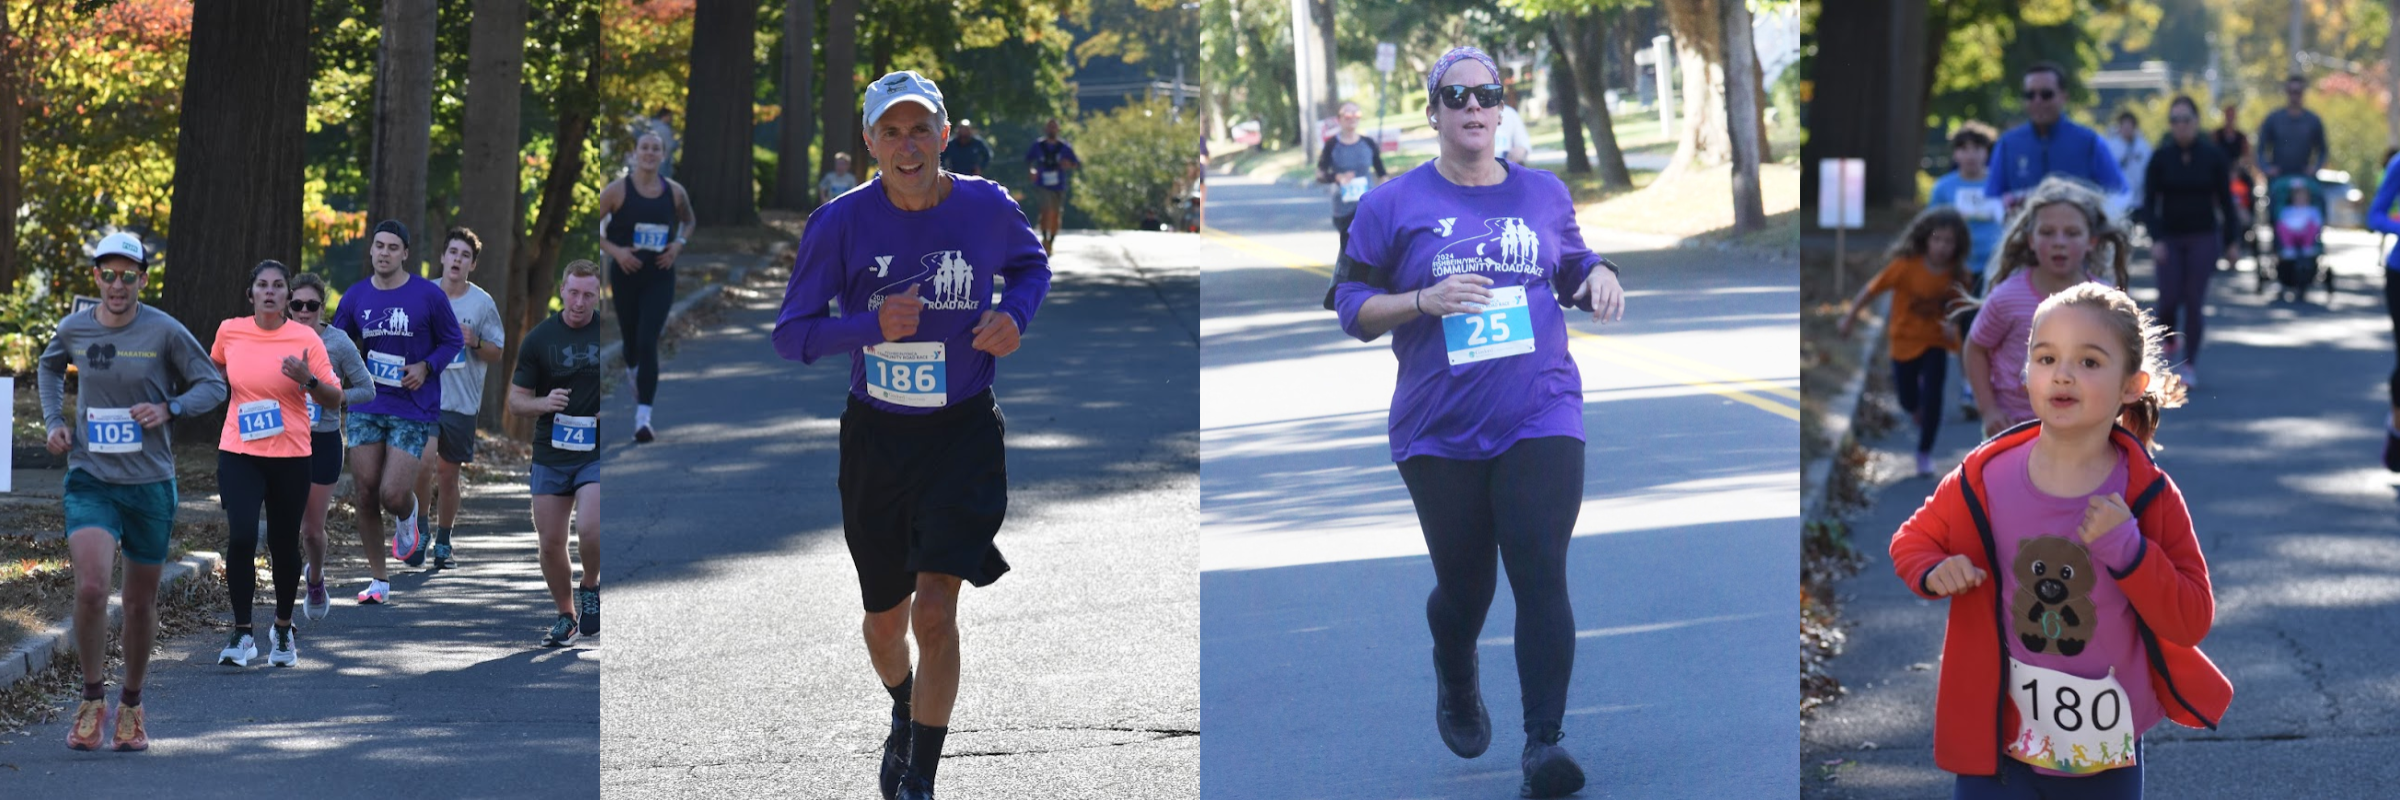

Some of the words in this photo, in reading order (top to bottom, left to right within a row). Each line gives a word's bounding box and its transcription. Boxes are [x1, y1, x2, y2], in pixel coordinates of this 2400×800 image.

[641, 233, 664, 246] 137
[1437, 253, 1454, 261] 2024
[1432, 262, 1492, 277] COMMUNITY
[1495, 262, 1524, 272] ROAD
[1523, 264, 1544, 277] RACE
[928, 301, 957, 310] ROAD
[957, 301, 979, 310] RACE
[1465, 312, 1510, 346] 25
[373, 362, 398, 379] 174
[877, 361, 936, 392] 186
[244, 412, 274, 432] 141
[94, 424, 134, 443] 105
[563, 427, 584, 443] 74
[2041, 610, 2062, 639] 6
[2022, 679, 2121, 732] 180
